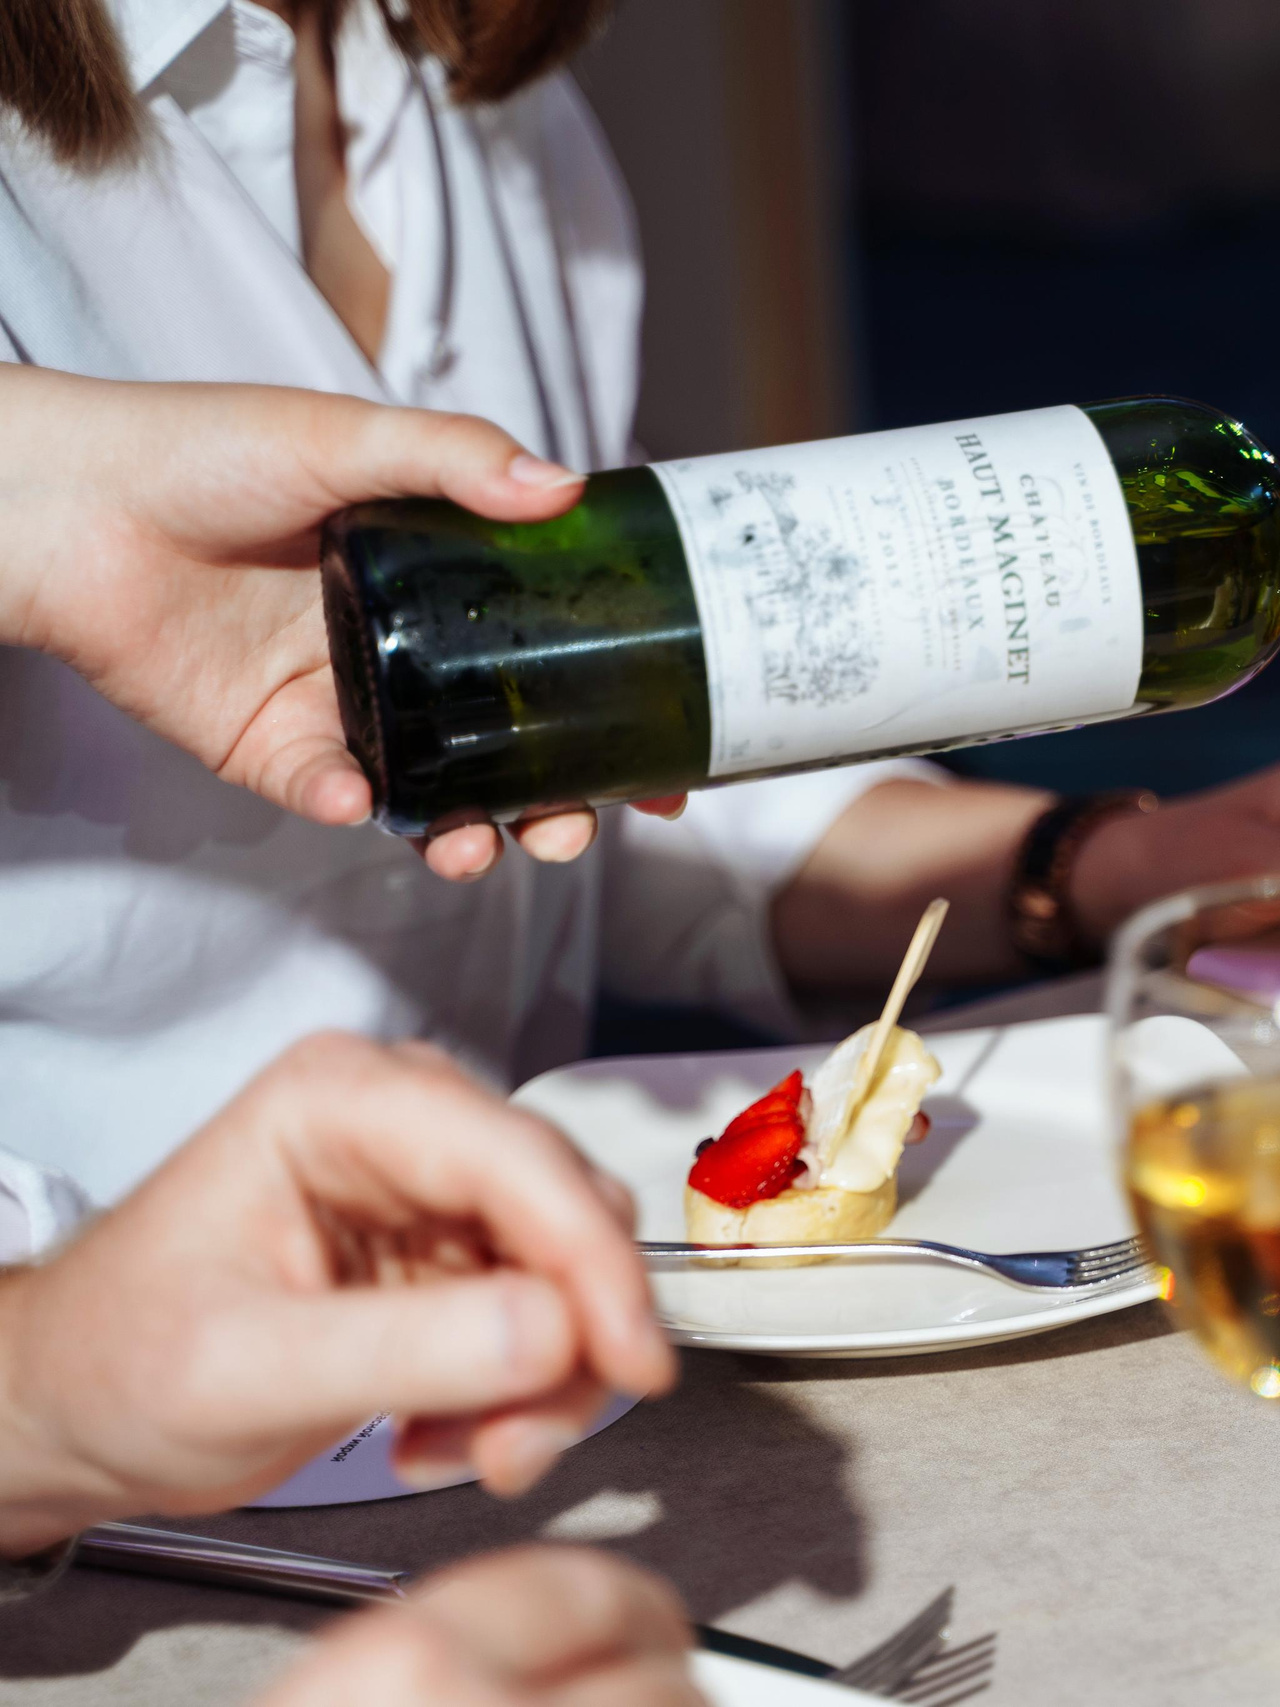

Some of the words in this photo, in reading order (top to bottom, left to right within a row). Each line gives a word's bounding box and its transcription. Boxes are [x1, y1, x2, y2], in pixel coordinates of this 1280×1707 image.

[936, 478, 986, 631] BORDEAUX
[955, 433, 1005, 503] HAUT
[987, 512, 1030, 684] MAGINET
[1073, 461, 1088, 487] VIN
[1082, 492, 1096, 511] DE
[1089, 518, 1112, 605] BORDEAUX
[330, 1438, 362, 1462] икрой
[357, 1407, 392, 1438] расной
